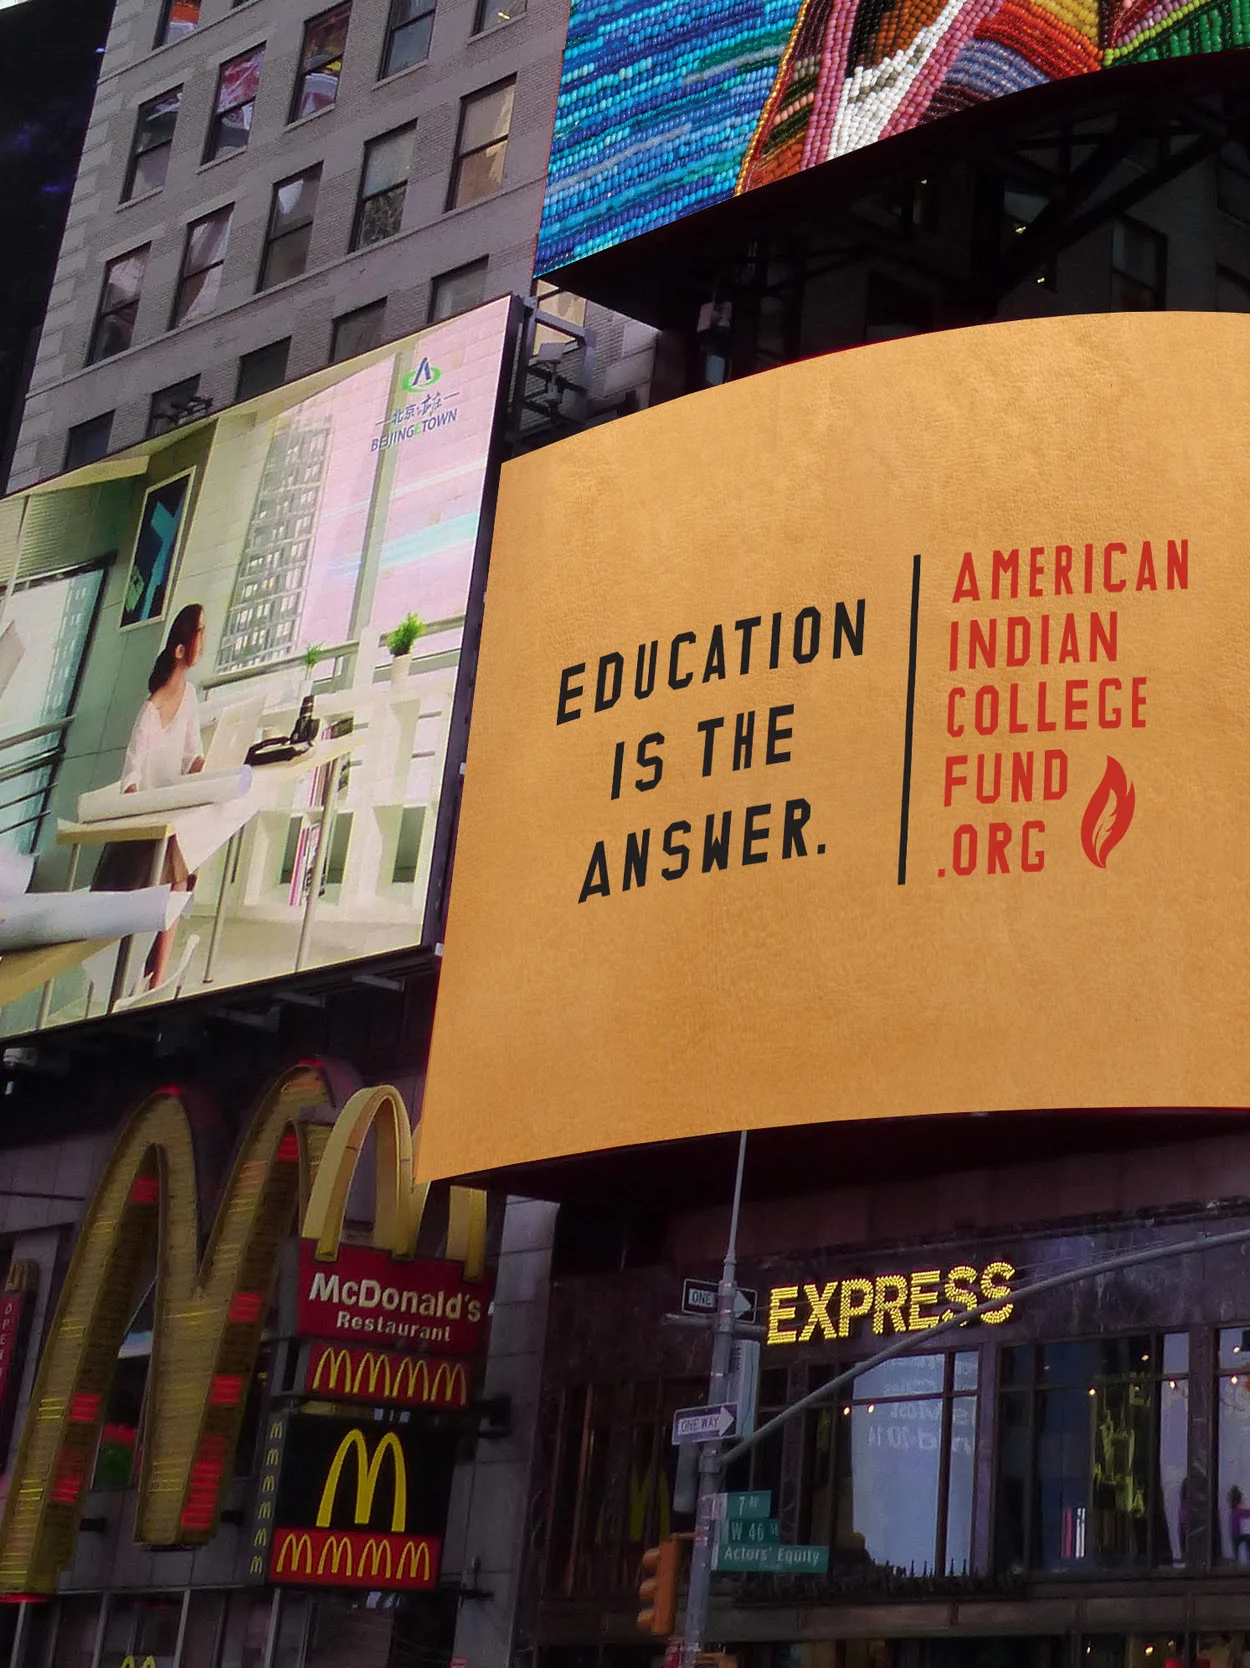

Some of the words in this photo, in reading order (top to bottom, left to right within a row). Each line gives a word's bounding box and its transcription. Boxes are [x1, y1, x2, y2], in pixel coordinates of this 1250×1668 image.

[952, 538, 1189, 604] AMERICAN
[556, 598, 866, 726] EDUCATION
[949, 611, 1118, 672] INDIAN
[946, 677, 1148, 738] COLLEGE
[610, 732, 665, 800] IS
[697, 703, 795, 778] THE
[943, 749, 1069, 807] FUND
[578, 798, 827, 904] ANSWER.
[937, 820, 1046, 878] .ORG
[309, 1272, 482, 1323] McDonald's
[336, 1310, 452, 1342] Restaurant
[692, 1290, 712, 1306] ONE
[767, 1262, 1015, 1345] EXPRESS
[680, 1417, 699, 1434] ONE
[700, 1415, 719, 1430] WAY
[731, 1521, 743, 1541] W
[748, 1523, 764, 1541] 46
[739, 1496, 745, 1516] 7
[724, 1547, 773, 1562] Actors'
[777, 1547, 820, 1567] Equity
